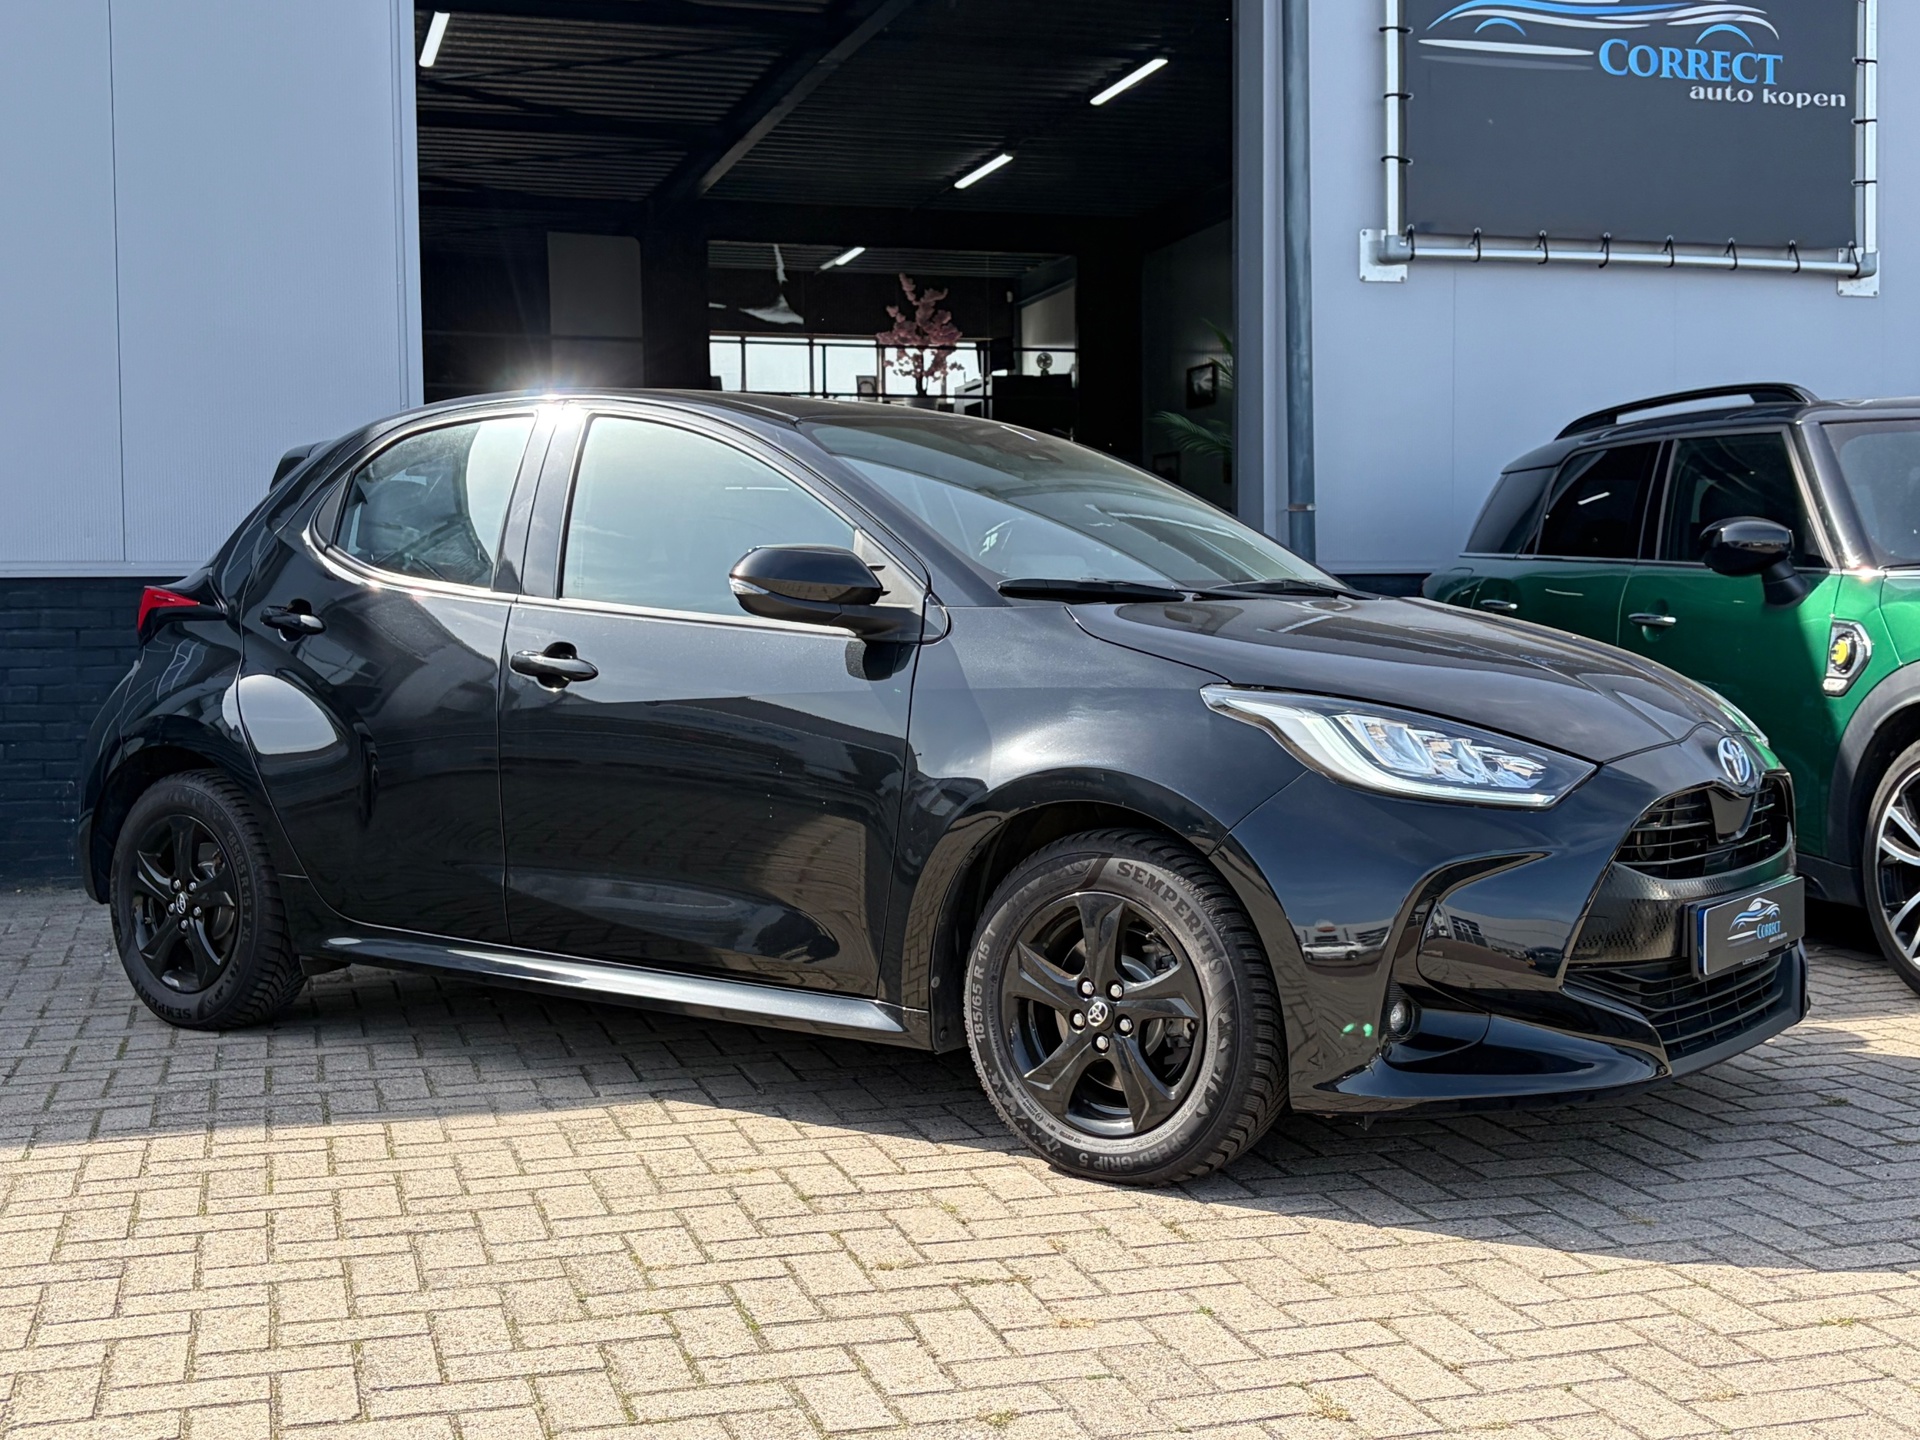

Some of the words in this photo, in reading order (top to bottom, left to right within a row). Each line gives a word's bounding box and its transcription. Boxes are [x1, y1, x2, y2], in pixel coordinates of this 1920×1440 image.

[1599, 38, 1783, 85] CORRECT
[1689, 84, 1754, 103] auto
[1762, 88, 1846, 109] kopen
[1117, 861, 1225, 957] SEMPERIT
[978, 941, 991, 961] 15
[974, 965, 985, 980] R
[972, 983, 986, 1043] 185/65
[1078, 1152, 1089, 1168] 5
[1093, 1129, 1191, 1172] SPEED-GRIP
